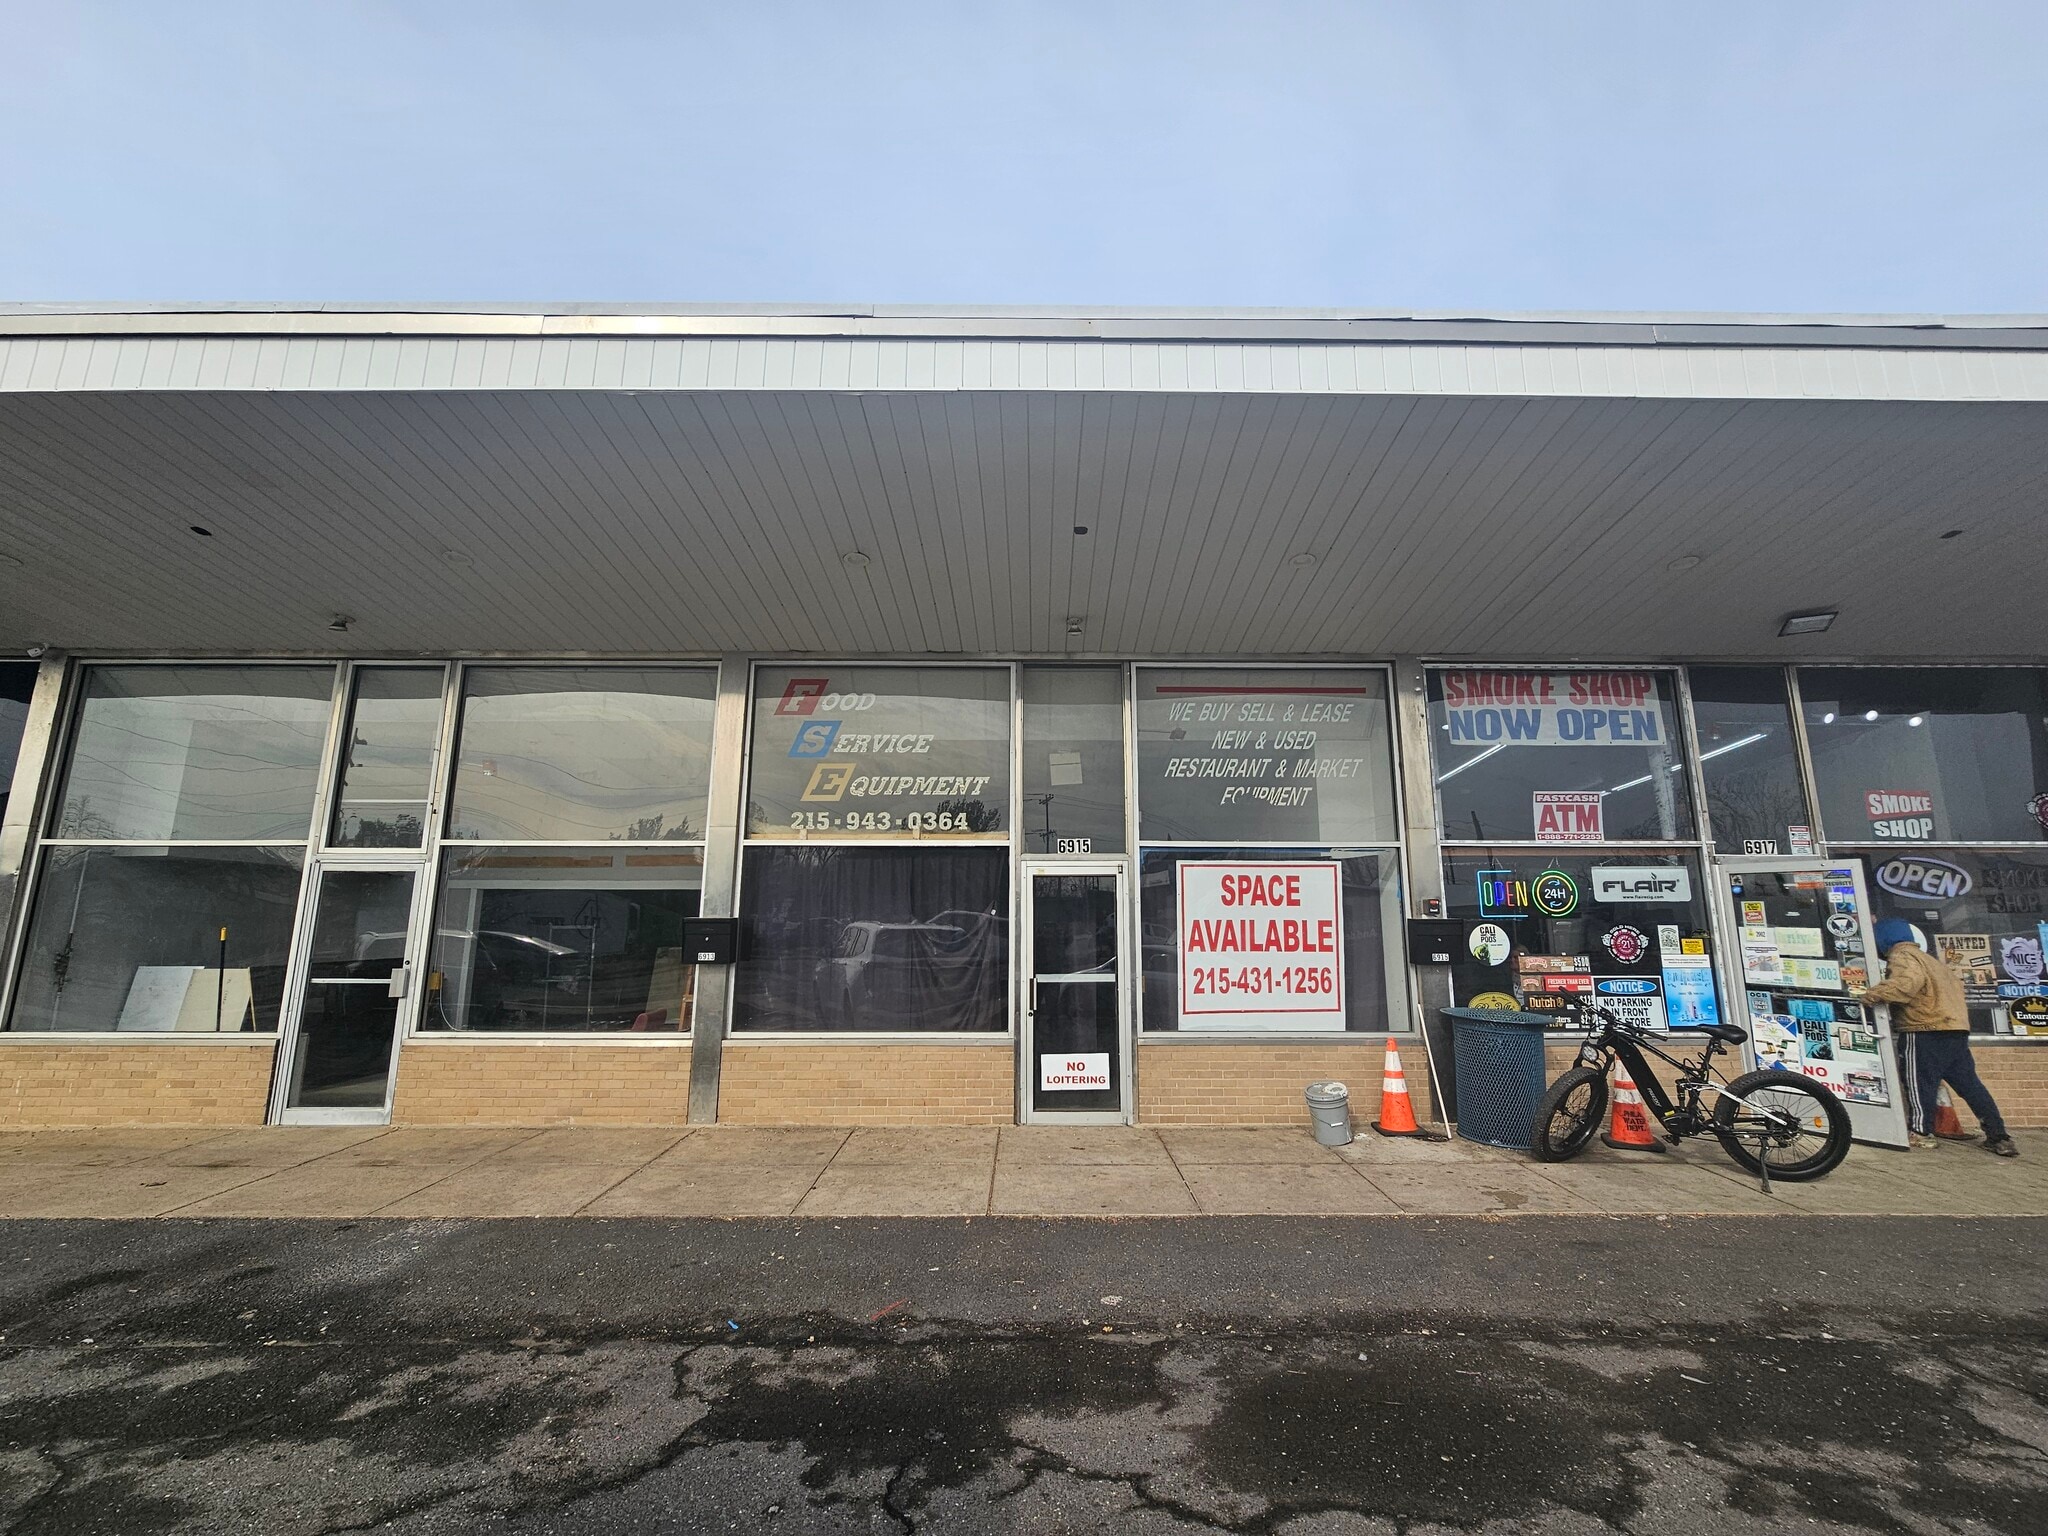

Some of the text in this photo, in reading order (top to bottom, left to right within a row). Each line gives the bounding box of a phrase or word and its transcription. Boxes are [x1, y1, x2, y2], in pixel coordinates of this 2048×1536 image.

[1445, 672, 1651, 707] SMOKE SHOP
[783, 684, 876, 712] FOOD
[1168, 702, 1354, 722] WE BUY SELL & LEASE
[1449, 708, 1659, 741] NOW OPEN
[797, 724, 934, 754] SERVICE
[1211, 730, 1317, 750] NEW & USED
[1164, 758, 1363, 778] RESTAURANT & MARKET
[809, 767, 990, 797] EQUIPMENT
[1536, 794, 1599, 802] FASTCASH
[1870, 793, 1931, 815] SMOKE
[791, 811, 968, 831] 215-943-0364
[1538, 804, 1599, 833] ATM
[1873, 817, 1933, 839] SHOP
[1058, 839, 1090, 853] 6915
[1745, 840, 1776, 855] 6917
[1603, 878, 1677, 893] FLAIR
[1883, 861, 1961, 898] OPEN
[1220, 874, 1301, 907] SPACE
[1483, 880, 1529, 907] OPEN
[1544, 887, 1566, 900] 24H
[1188, 919, 1334, 953] AVAILABLE
[1480, 926, 1496, 934] CALI
[1621, 940, 1631, 949] 21
[1937, 936, 1986, 950] WANTED
[1432, 953, 1449, 961] 6915
[2012, 953, 2037, 965] NICE
[1193, 966, 1333, 995] 215-431-1256
[1815, 967, 1839, 981] 2003
[1609, 981, 1644, 992] NOTICE
[2004, 985, 2042, 996] NOTICE
[1529, 997, 1556, 1008] Dutch
[1603, 998, 1615, 1007] NO
[1617, 998, 1652, 1007] PARKING
[1611, 1008, 1649, 1017] IN FRONT
[1624, 1017, 1652, 1027] STORE
[1804, 1020, 1827, 1030] CALI
[1805, 1031, 1829, 1042] PODS
[1067, 1062, 1086, 1072] NO
[1803, 1065, 1828, 1077] NO
[1046, 1075, 1106, 1084] LOITERING
